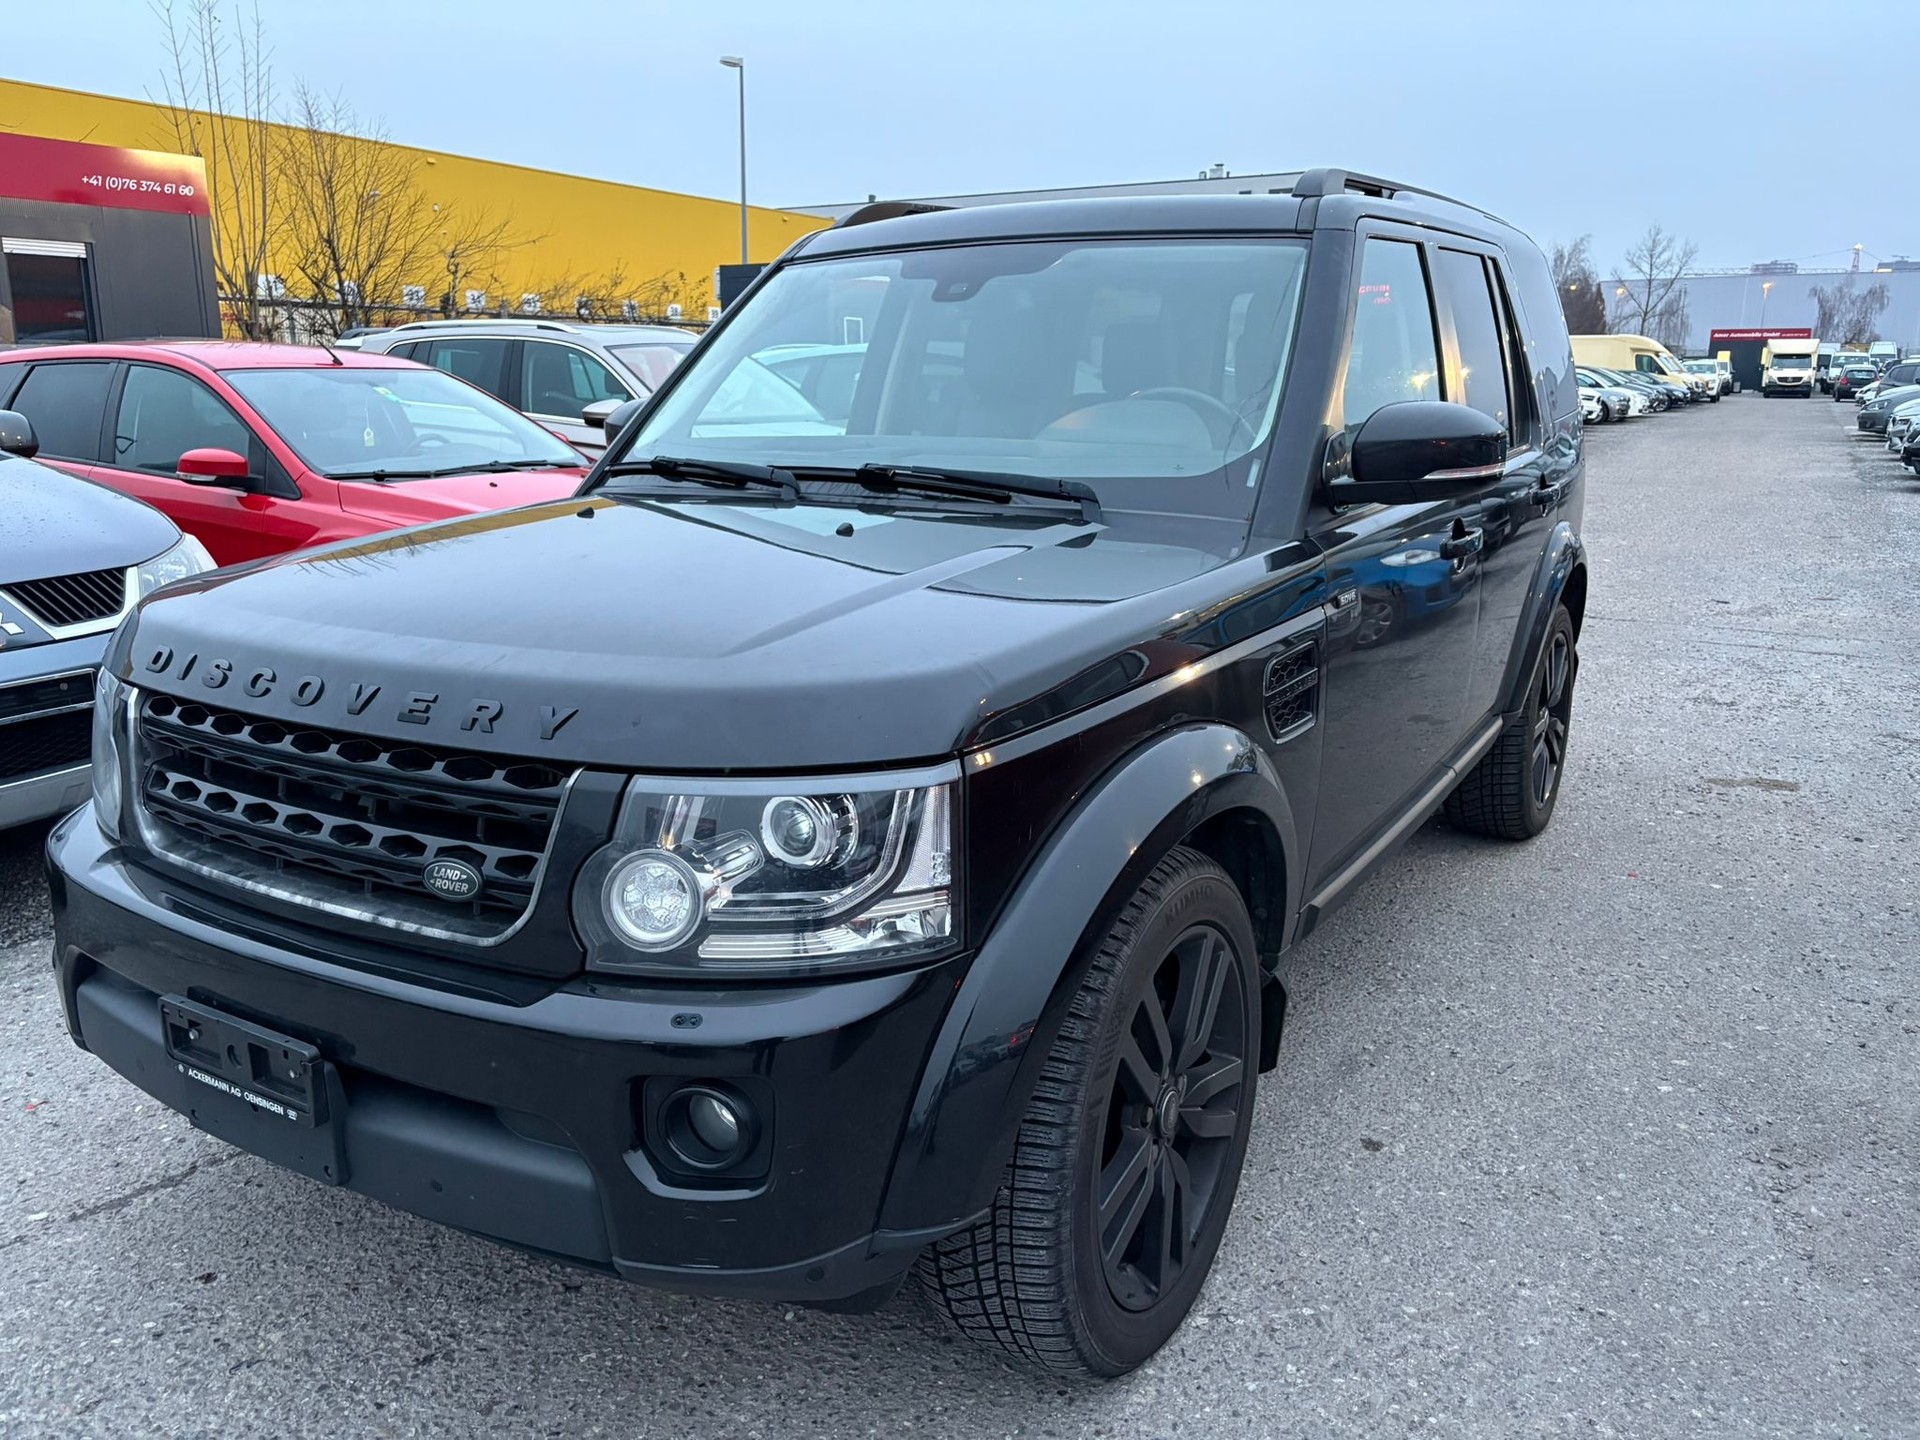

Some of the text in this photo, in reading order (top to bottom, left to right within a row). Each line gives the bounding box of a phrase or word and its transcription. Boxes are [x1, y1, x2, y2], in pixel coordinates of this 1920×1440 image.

[82, 175, 194, 197] +41 (0)76 374 61 60
[145, 644, 579, 741] DISCOVERY
[433, 866, 461, 881] LAND
[434, 878, 469, 893] ROVER
[188, 1068, 284, 1115] ACKERMANN AG OENSINGEN
